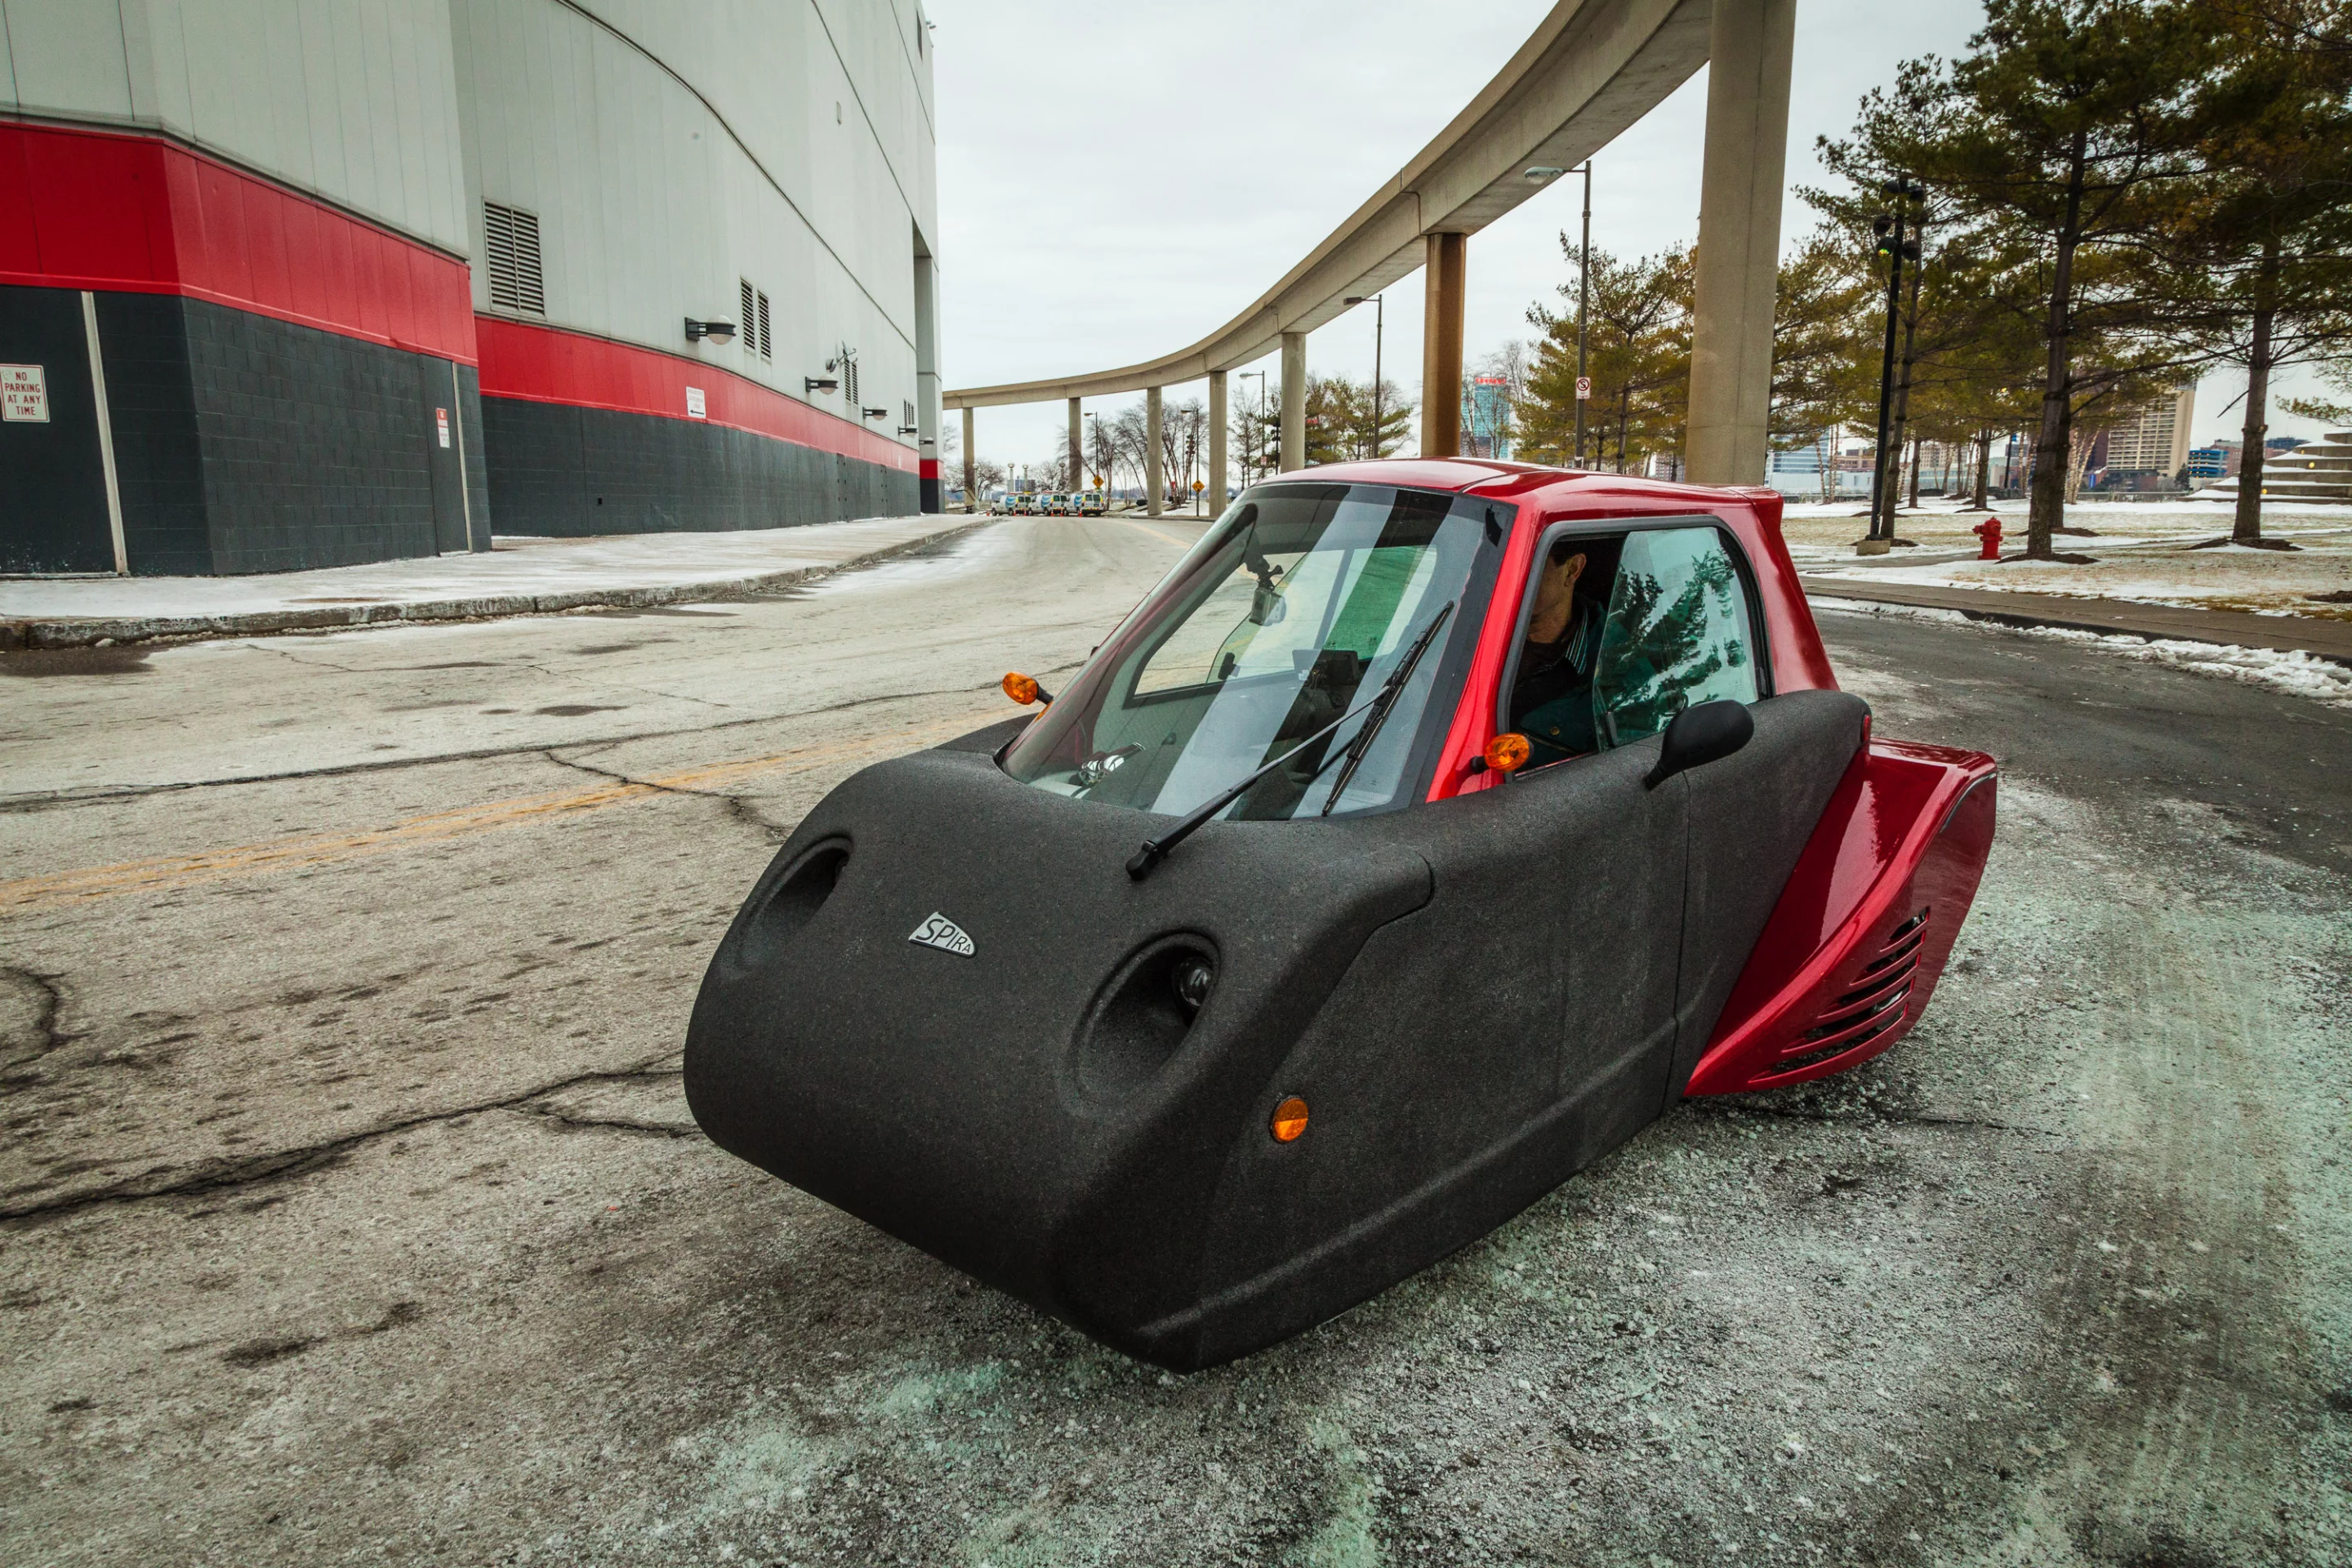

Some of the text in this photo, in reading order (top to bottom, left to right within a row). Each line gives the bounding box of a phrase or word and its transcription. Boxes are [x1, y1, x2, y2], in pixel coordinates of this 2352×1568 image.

[16, 372, 27, 381] NO
[5, 383, 41, 393] PARKING
[7, 394, 41, 404] AT ANY
[16, 406, 36, 416] TIME
[915, 918, 970, 953] SPIRA
